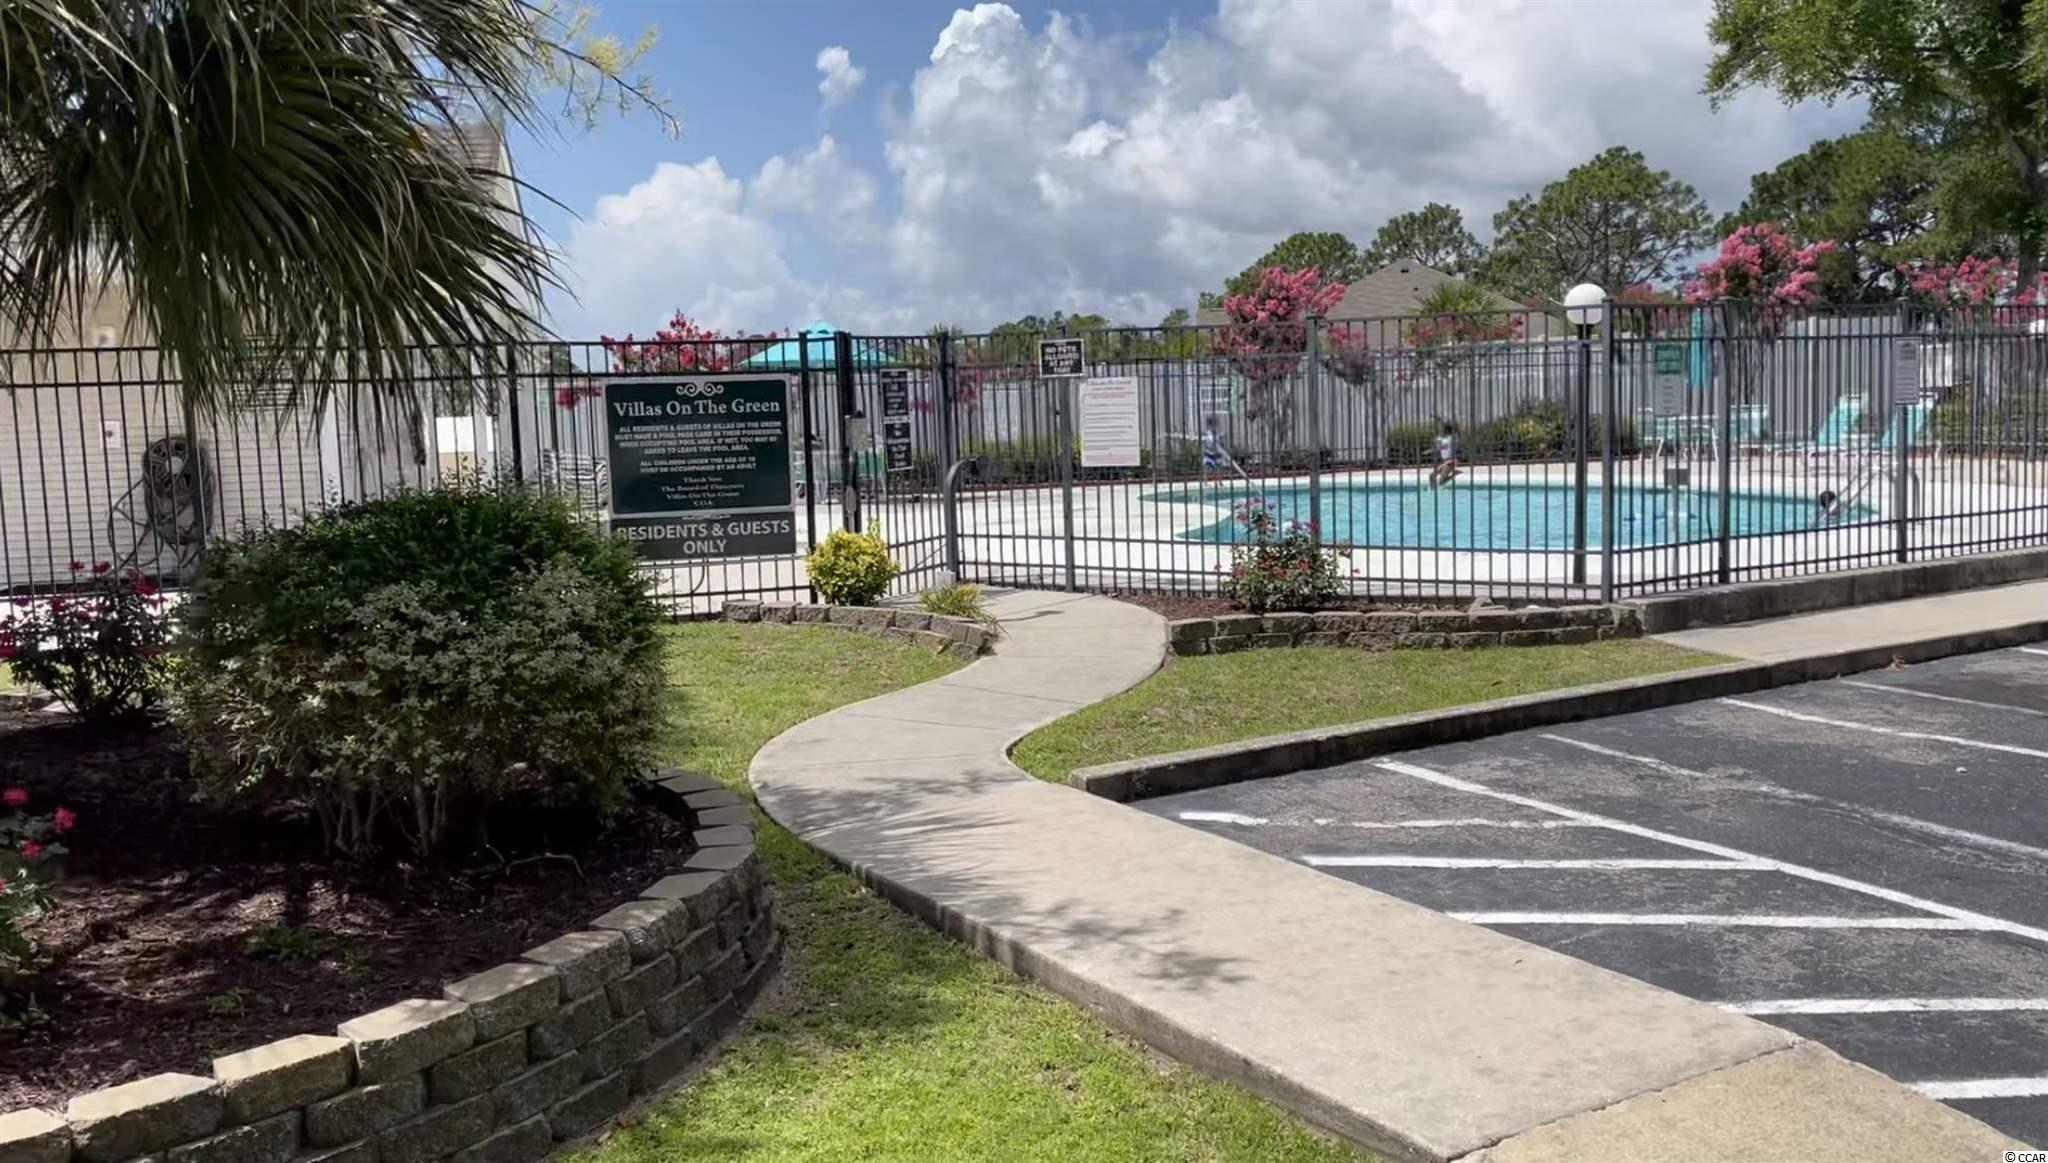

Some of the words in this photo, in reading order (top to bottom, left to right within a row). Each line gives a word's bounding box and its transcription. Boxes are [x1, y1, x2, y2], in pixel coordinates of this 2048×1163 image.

[613, 401, 662, 416] Villas
[666, 400, 692, 416] On
[694, 399, 727, 414] The
[731, 398, 780, 413] Green
[616, 524, 707, 540] RESIDENTS
[712, 522, 724, 536] &
[728, 520, 790, 536] GUESTS
[683, 539, 726, 554] ONLY
